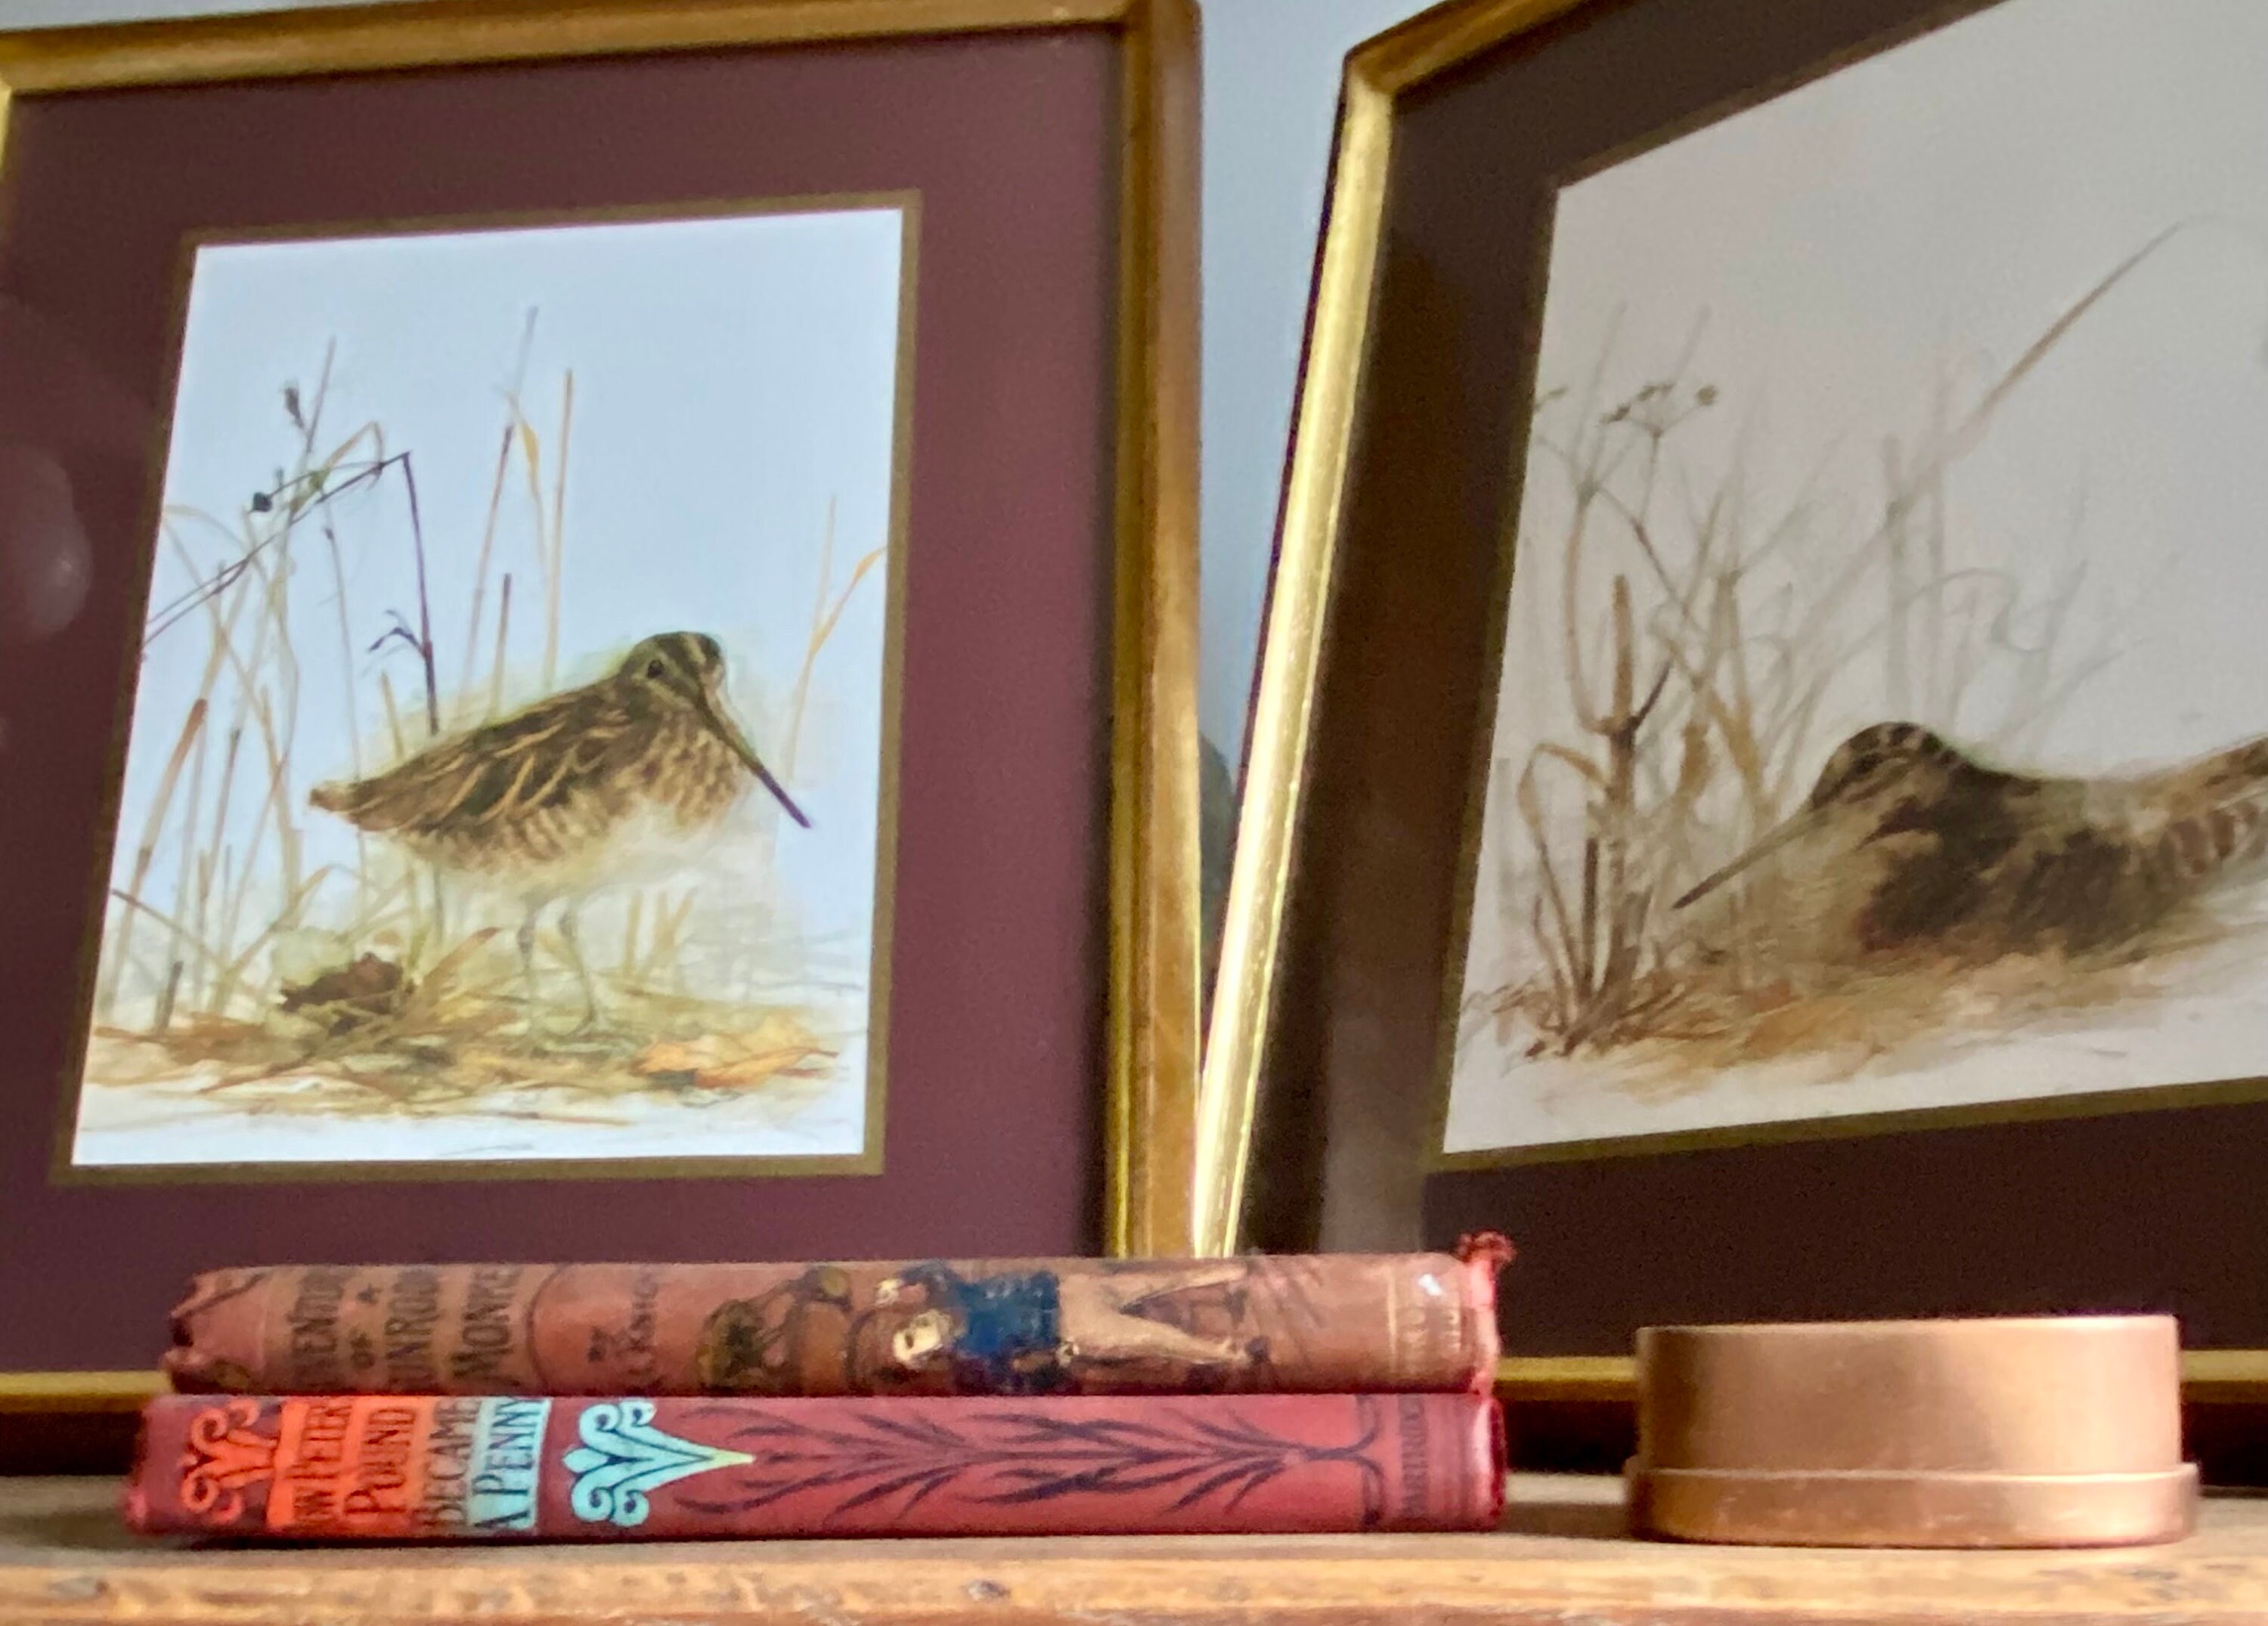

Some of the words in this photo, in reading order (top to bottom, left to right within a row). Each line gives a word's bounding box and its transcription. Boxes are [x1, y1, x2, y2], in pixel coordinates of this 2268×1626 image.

[343, 1408, 417, 1514] POUND
[420, 1398, 482, 1526] BECAME
[472, 1396, 544, 1495] PENNY
[474, 1509, 531, 1533] A
